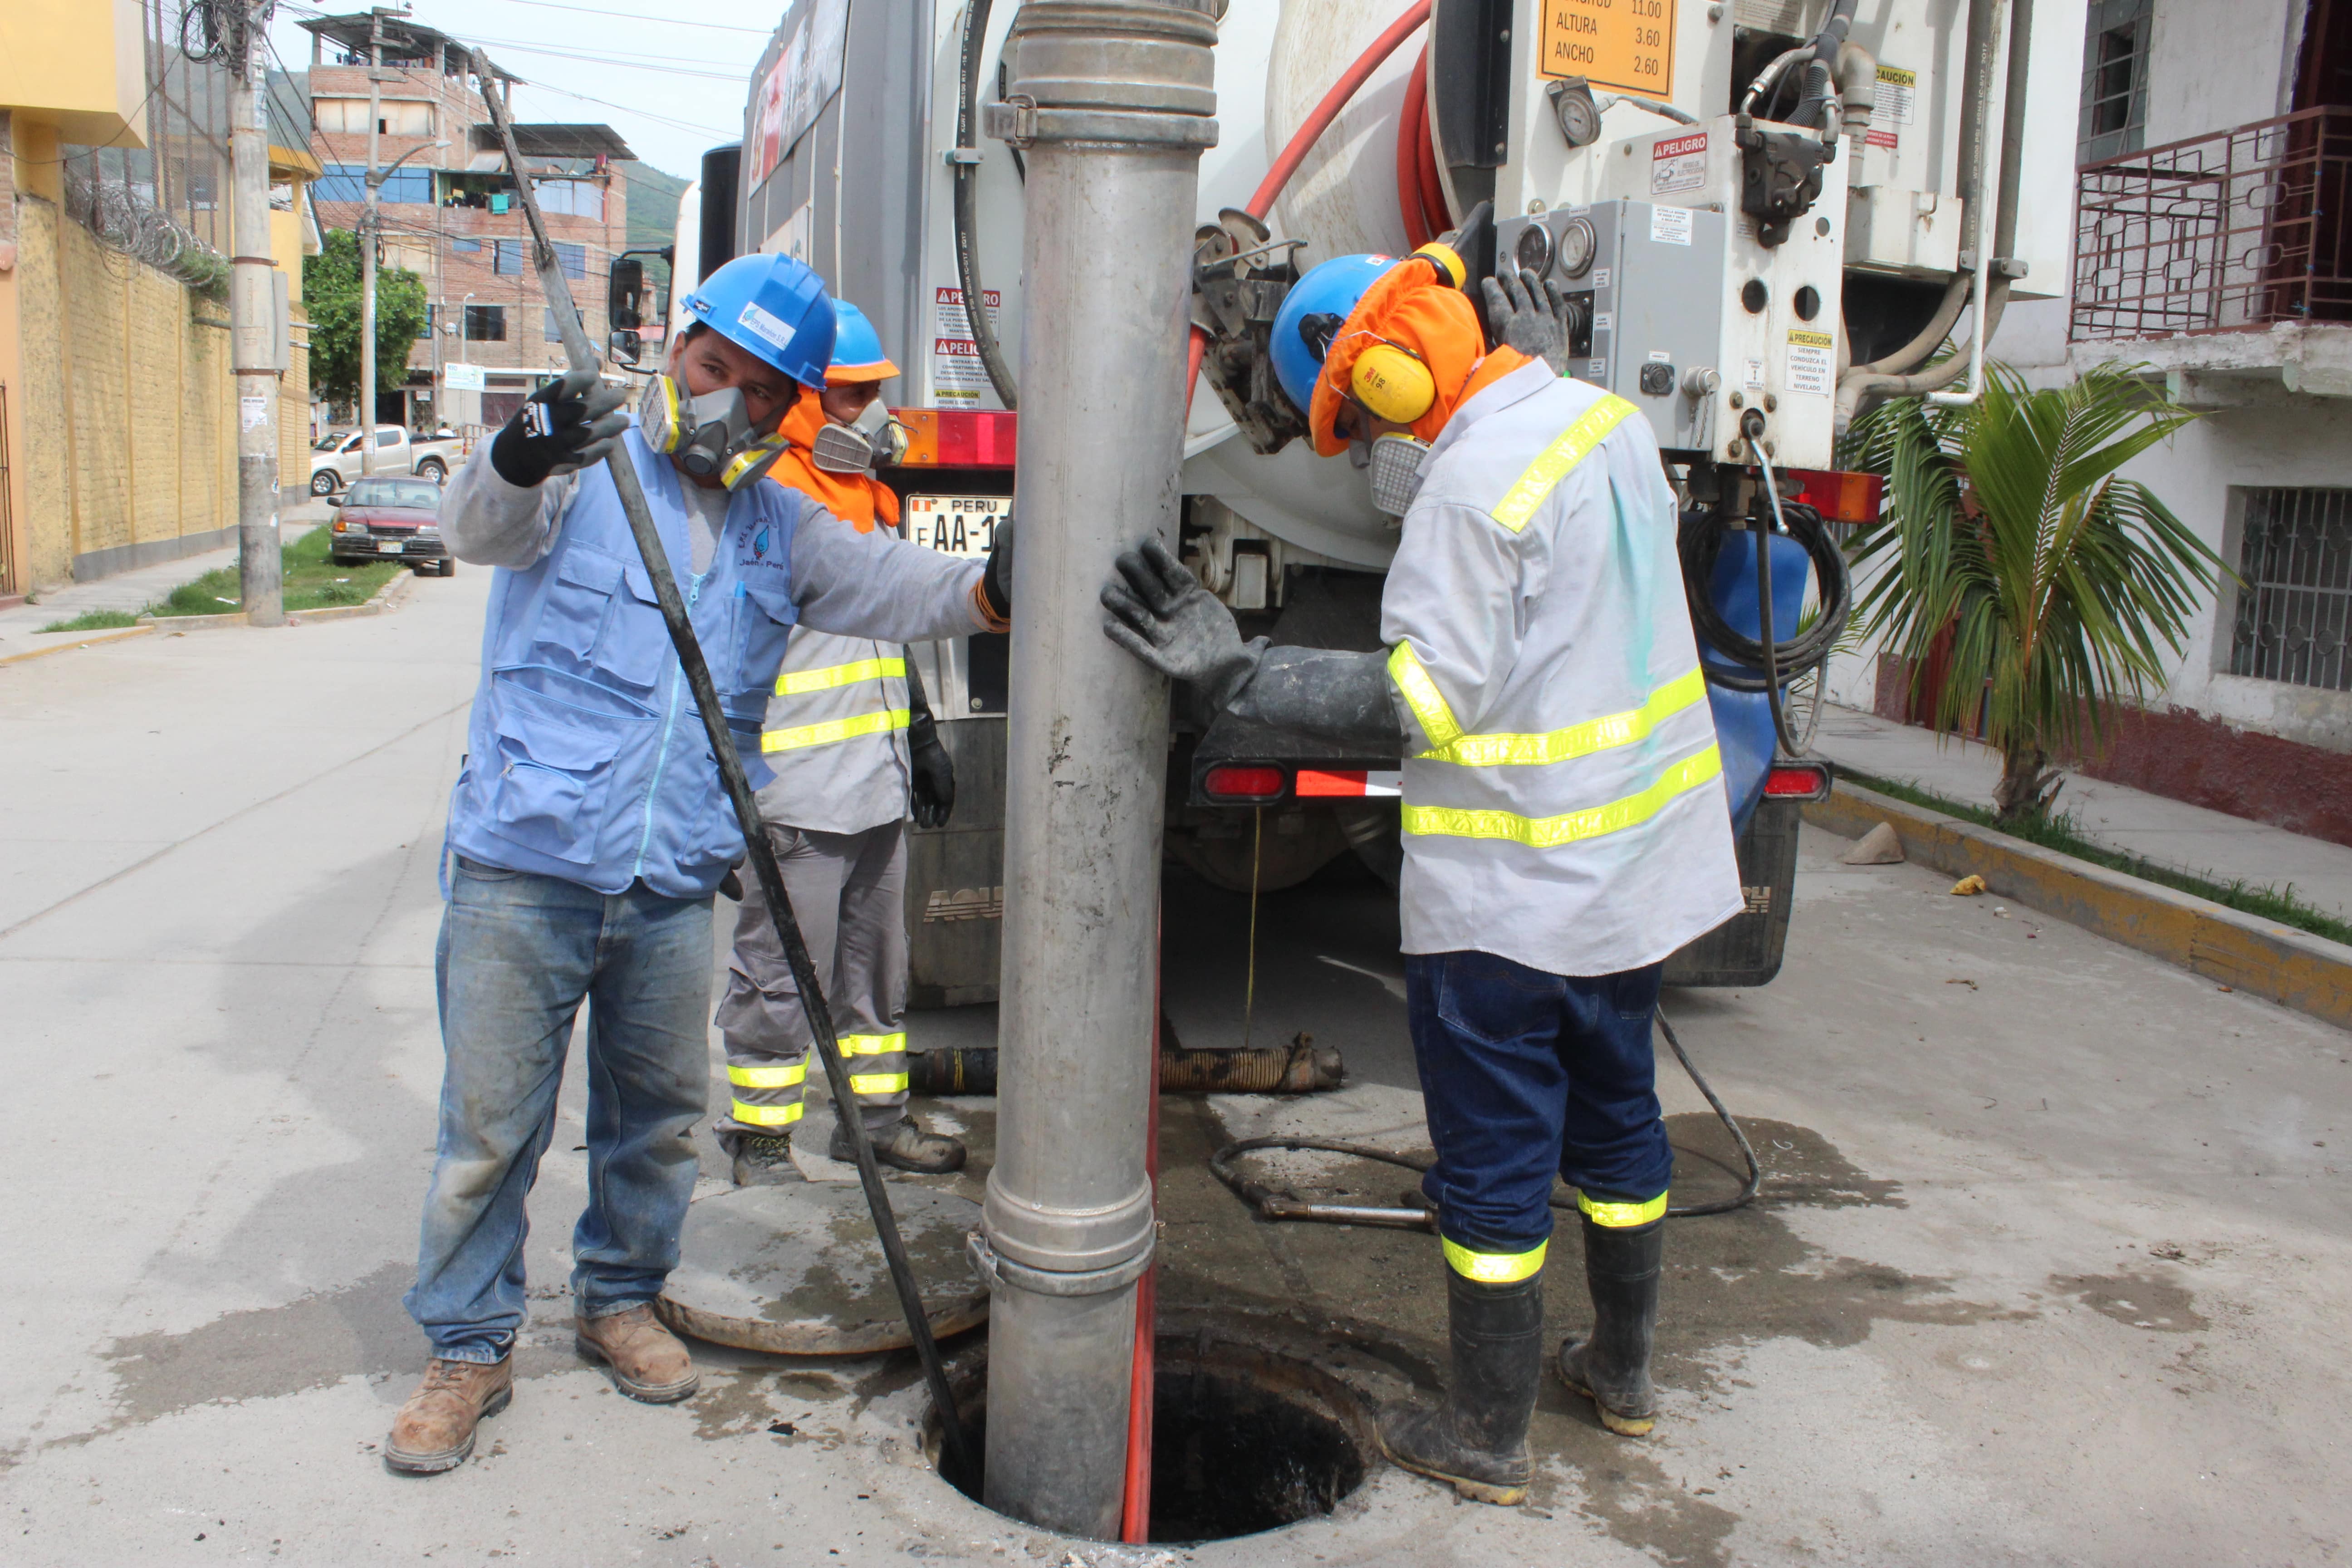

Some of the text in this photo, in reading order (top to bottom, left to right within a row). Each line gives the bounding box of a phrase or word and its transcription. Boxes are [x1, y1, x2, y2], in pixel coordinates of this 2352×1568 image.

[1632, 0, 1661, 19] 11.00
[1556, 12, 1660, 47] ALTURA 3.60
[1555, 41, 1658, 75] ANCHO 2.60
[1876, 69, 1914, 85] CAUCIÓN
[1663, 137, 1706, 155] PELIGRO
[951, 292, 999, 305] PERO
[1795, 333, 1832, 346] PRECAUCIÓN
[950, 342, 980, 355] PELI
[1790, 355, 1819, 364] CONDUZCA
[1364, 367, 1376, 382] 3M
[1791, 364, 1817, 373] VEHÍCULO
[1376, 377, 1386, 390] 98
[952, 500, 997, 513] PERU
[740, 558, 759, 566] Jaén
[766, 561, 784, 570] Perú
